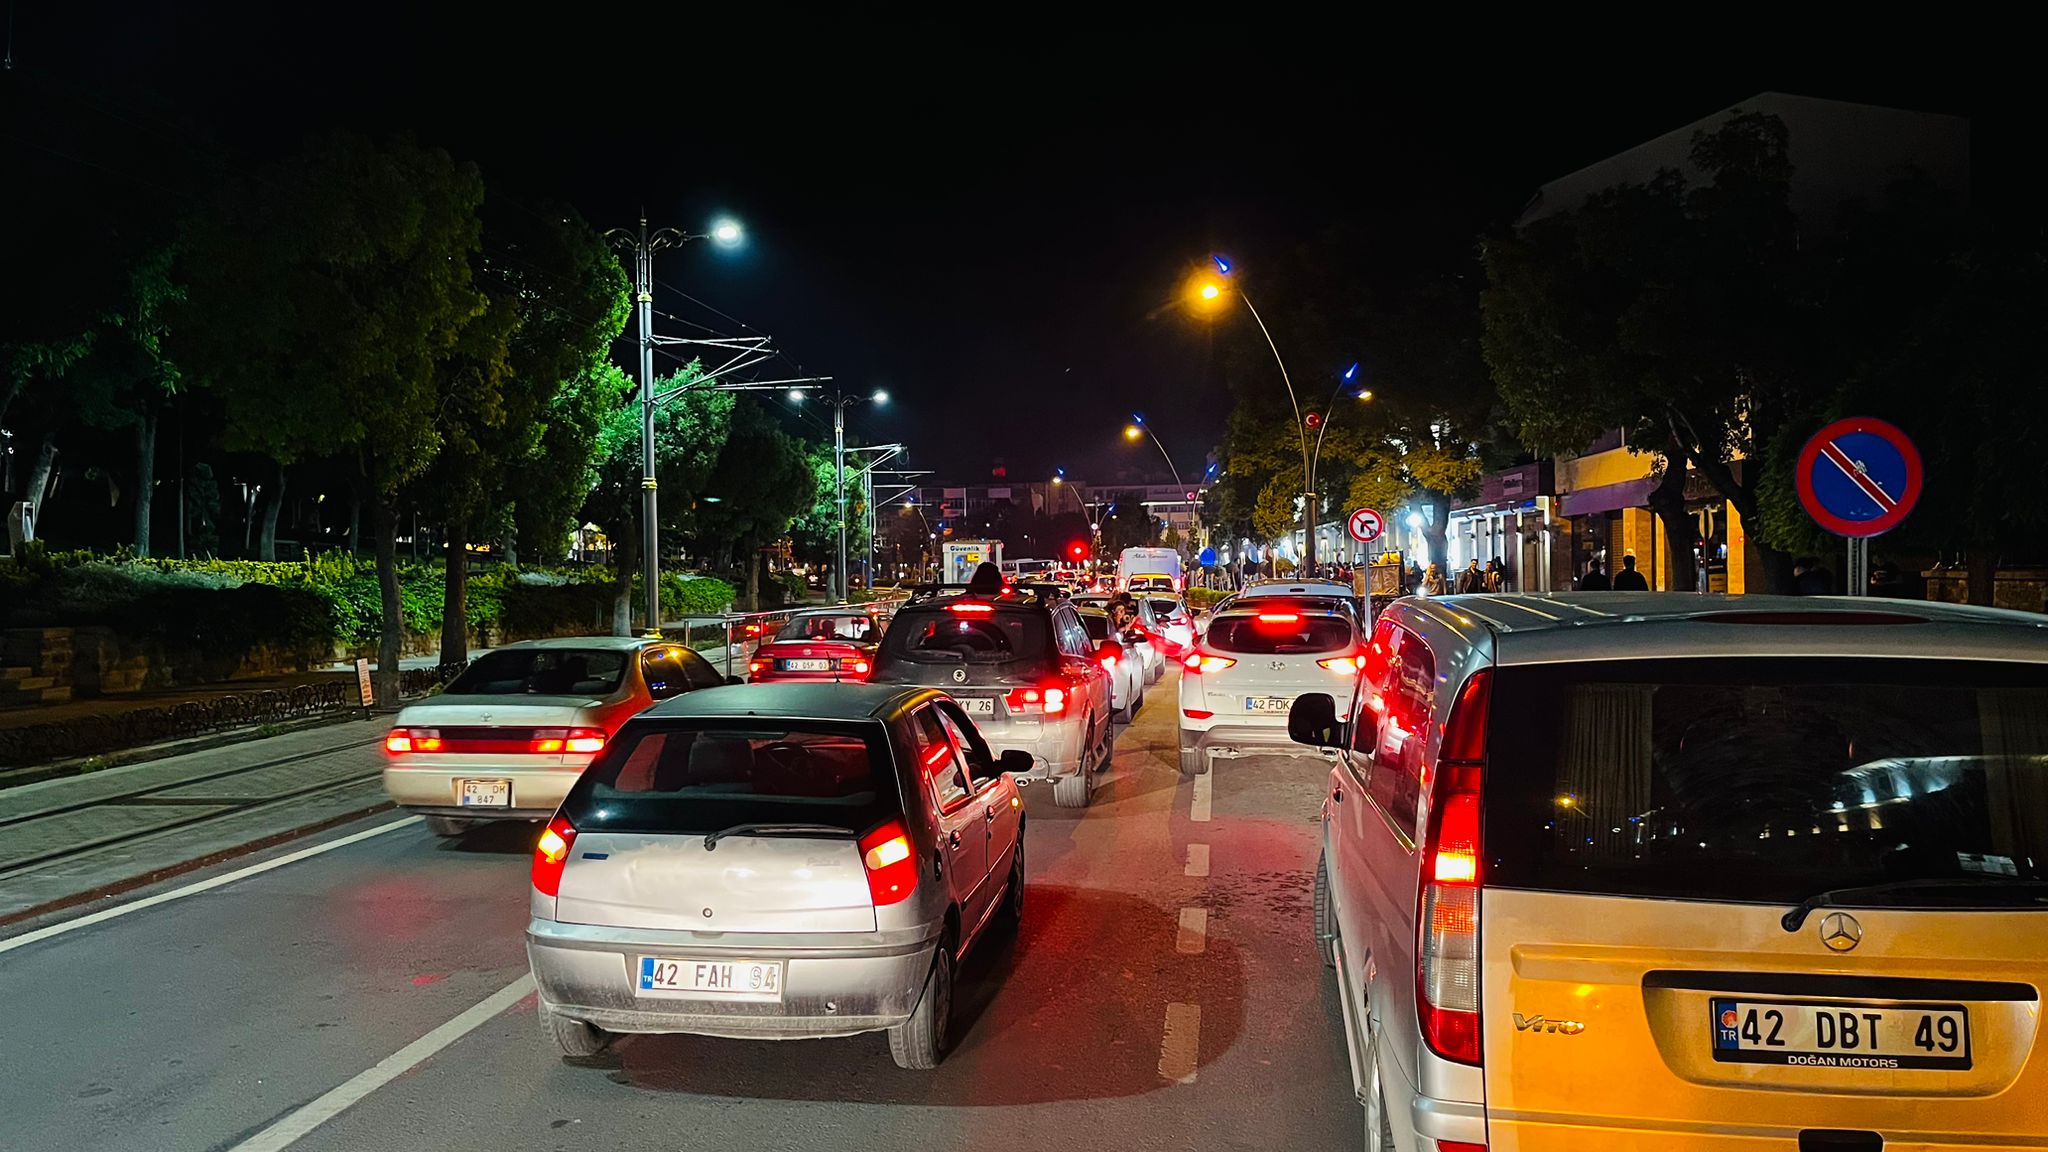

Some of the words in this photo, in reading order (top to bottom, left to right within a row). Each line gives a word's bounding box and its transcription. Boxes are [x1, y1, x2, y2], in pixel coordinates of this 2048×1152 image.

[979, 700, 991, 712] 26
[1252, 700, 1265, 710] 42
[466, 785, 478, 794] 42
[654, 963, 678, 985] 42
[695, 964, 733, 988] FAH
[1720, 1030, 1737, 1041] TR
[1741, 1009, 1786, 1047] 42
[1816, 1011, 1883, 1050] DBT
[1914, 1015, 1959, 1053] 49
[1787, 1054, 1837, 1066] DOĞAN
[1839, 1057, 1898, 1068] MOTORS
